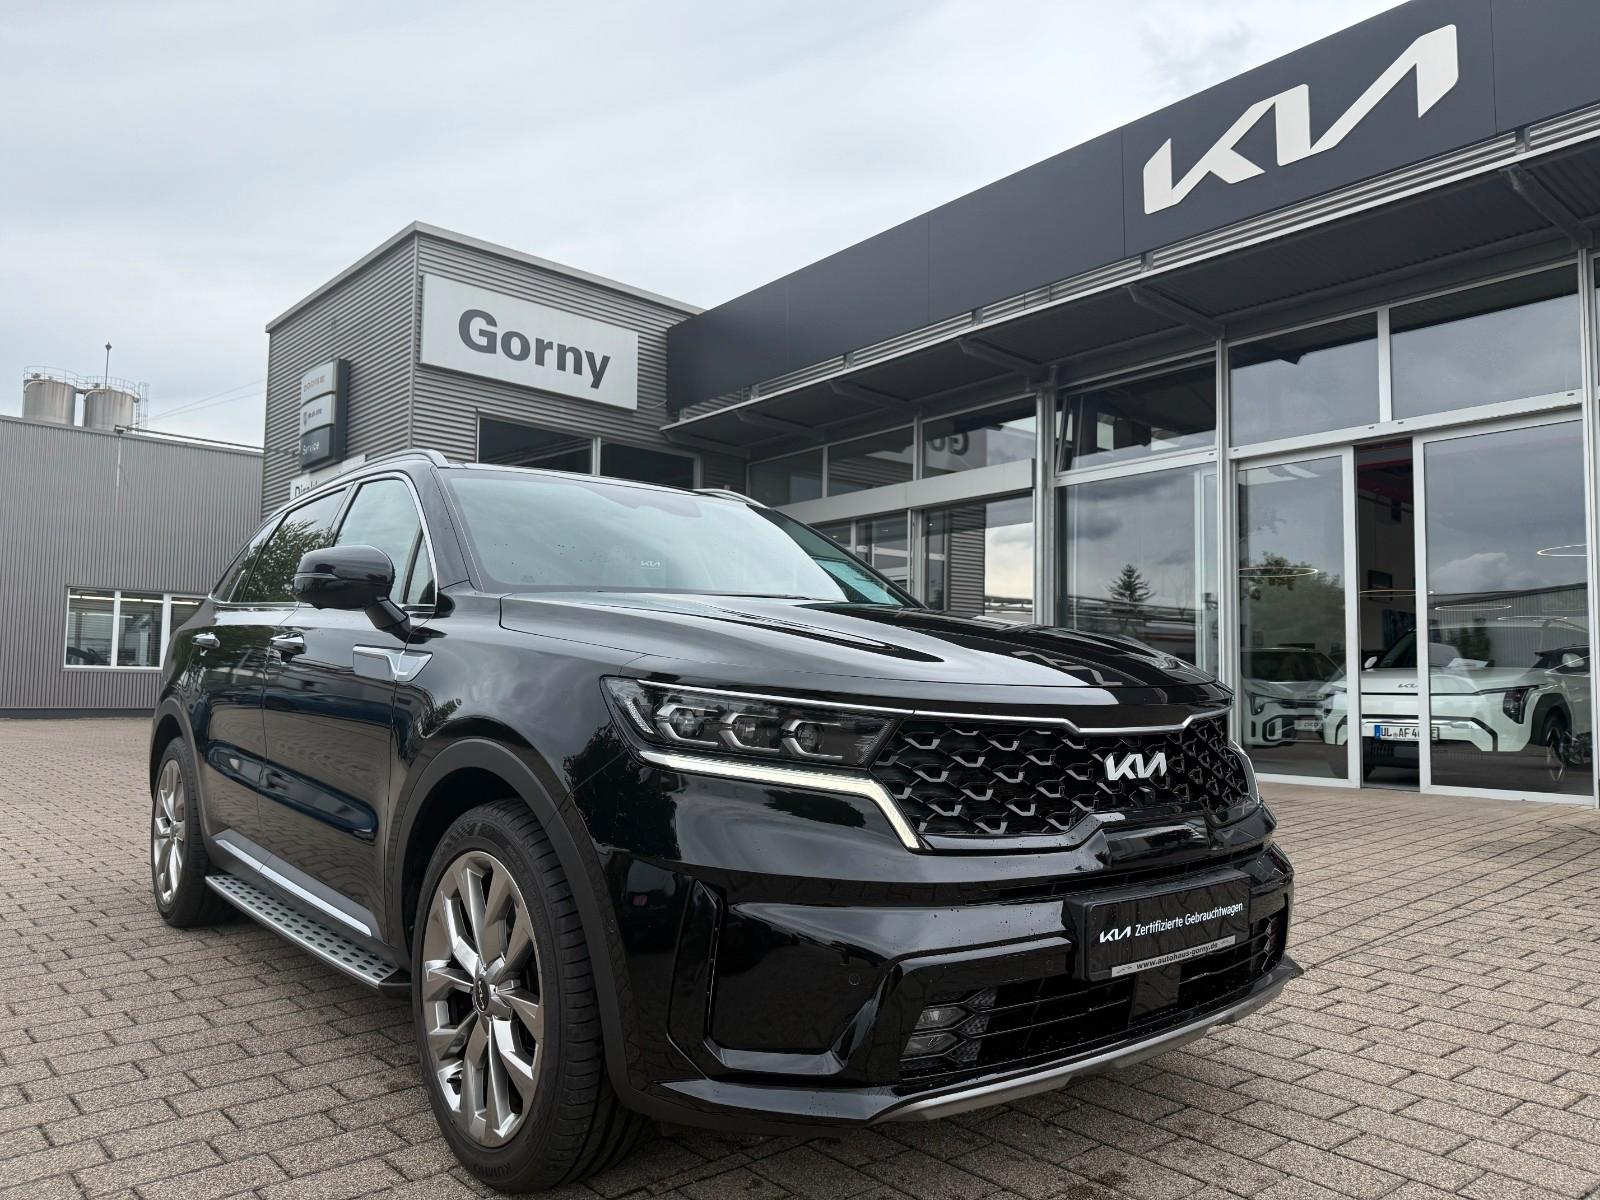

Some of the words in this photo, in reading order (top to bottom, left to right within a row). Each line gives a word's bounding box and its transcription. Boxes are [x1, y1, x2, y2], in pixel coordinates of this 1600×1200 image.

[1143, 24, 1458, 214] KIA
[458, 309, 610, 389] Gorny
[1381, 727, 1392, 737] UL
[1398, 728, 1410, 738] AF
[1104, 751, 1167, 781] KIA
[1099, 926, 1132, 943] KIA
[1135, 917, 1183, 936] Zertifizierte
[1184, 902, 1243, 926] Gebrauchtwagen
[1136, 942, 1218, 970] www.autohaus-gorny.de
